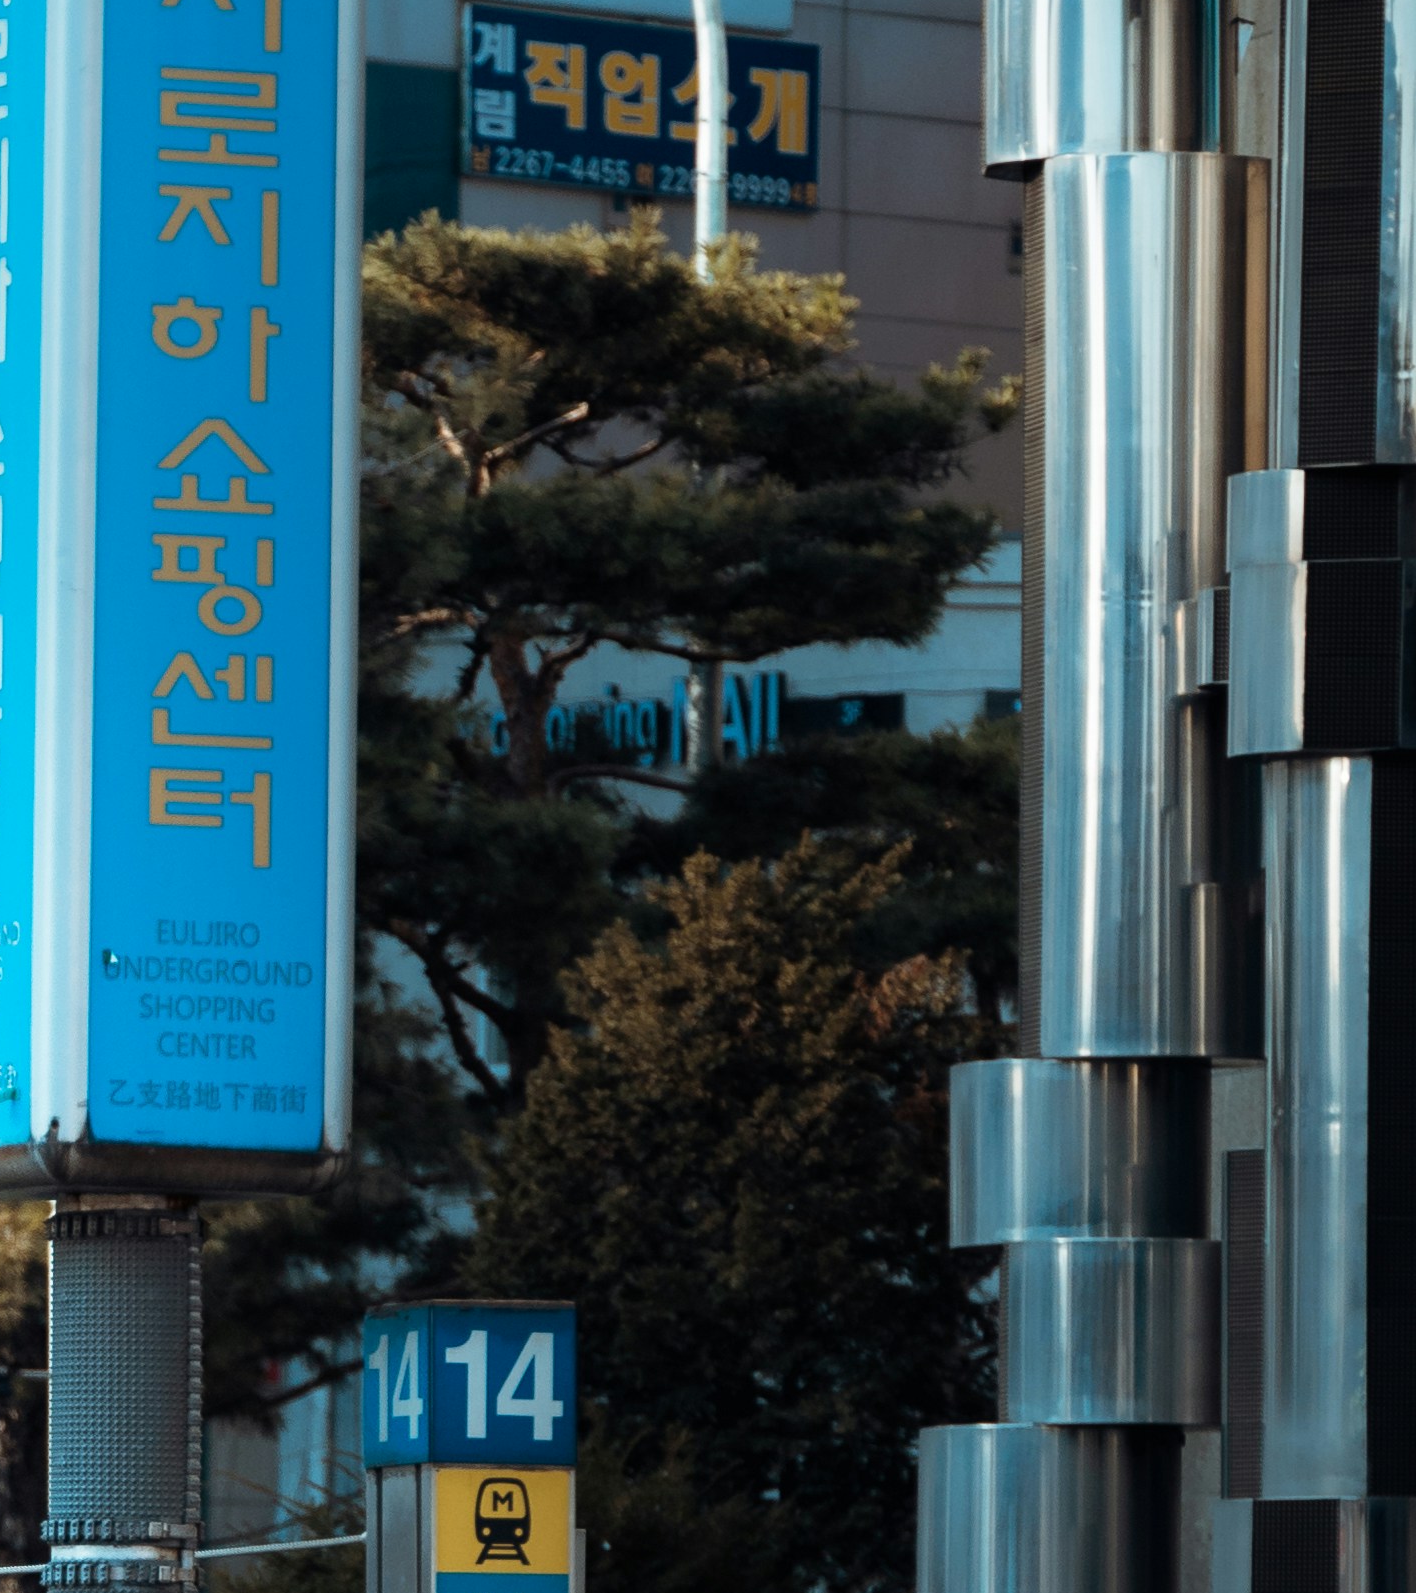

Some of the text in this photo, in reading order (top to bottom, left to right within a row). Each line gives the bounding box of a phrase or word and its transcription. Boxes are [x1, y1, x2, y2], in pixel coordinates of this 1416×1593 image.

[473, 20, 517, 141] 계림
[156, 918, 261, 949] EULJIRO
[103, 955, 313, 988] UNDERGROUND
[138, 992, 276, 1025] SHOPPING
[156, 1030, 258, 1060] CENTER
[368, 1330, 424, 1443] 14
[444, 1329, 564, 1441] 14
